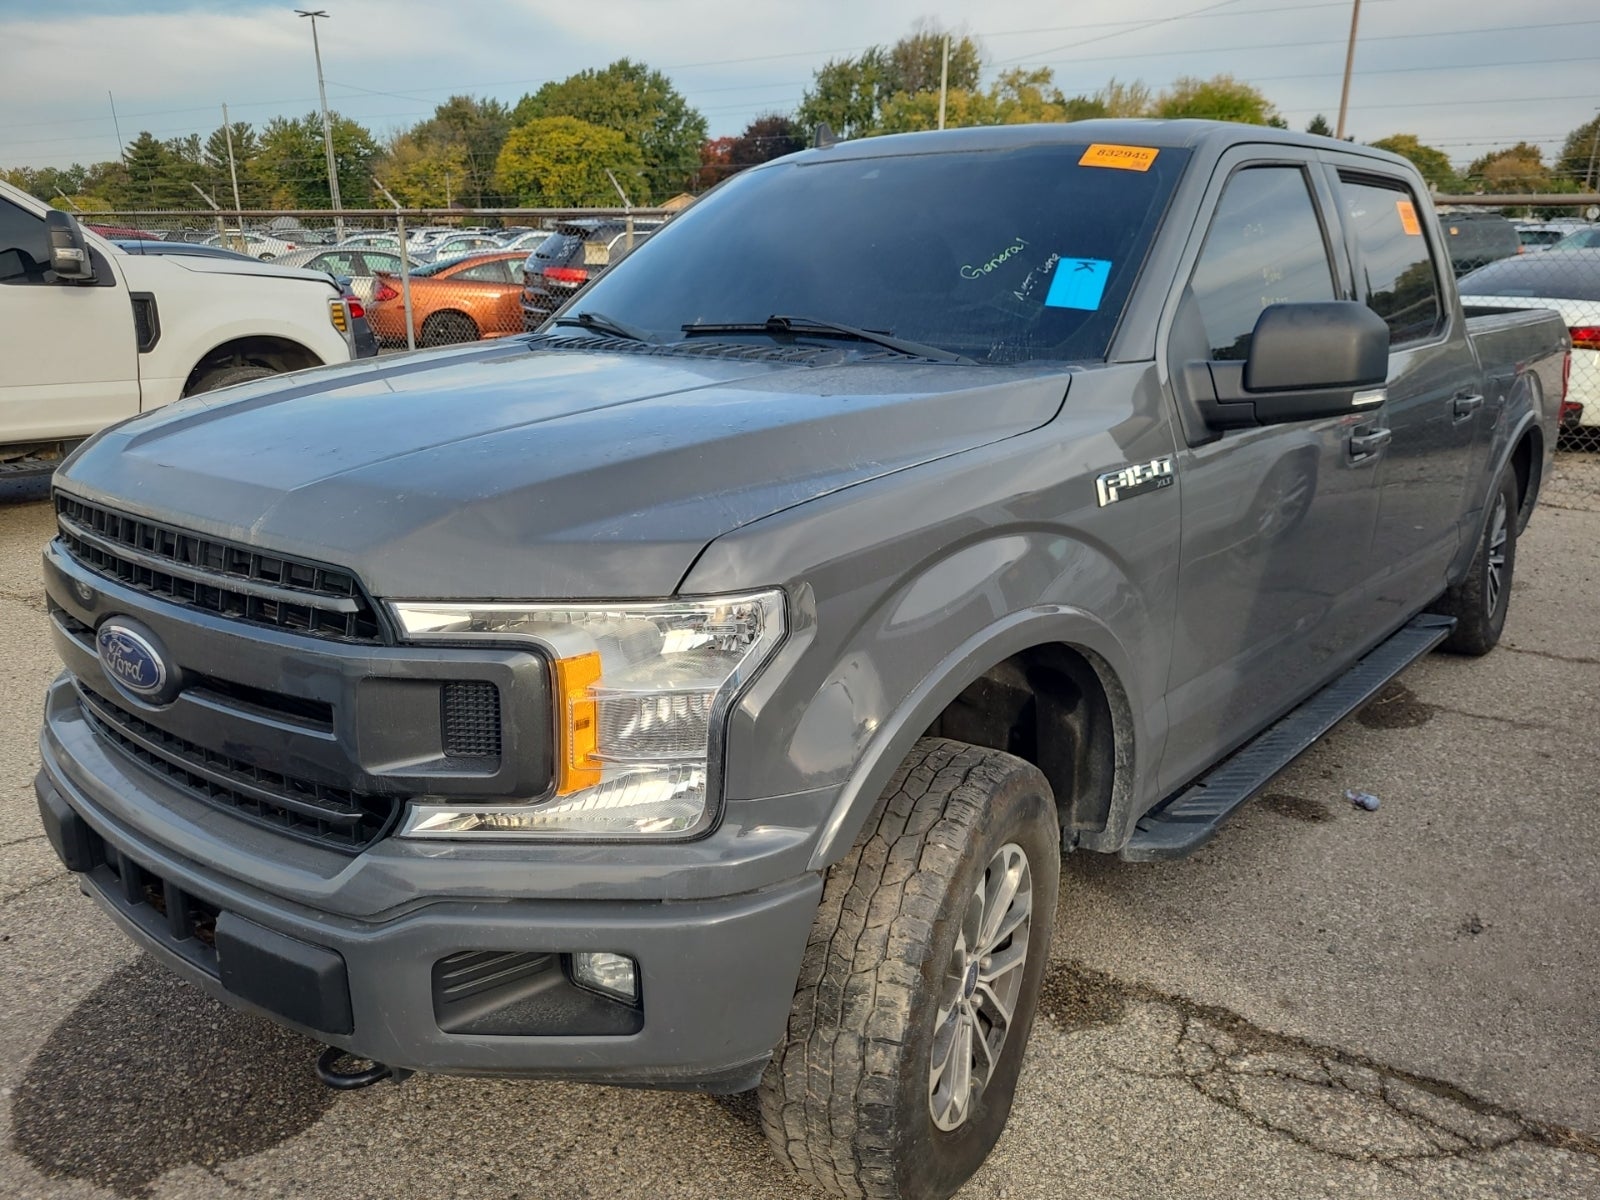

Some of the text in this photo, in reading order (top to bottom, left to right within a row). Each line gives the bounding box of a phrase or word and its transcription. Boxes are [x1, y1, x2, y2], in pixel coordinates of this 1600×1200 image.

[1097, 149, 1149, 160] 832945
[960, 237, 1029, 279] General
[1074, 261, 1097, 273] K
[1156, 478, 1171, 488] XLT
[107, 639, 143, 681] Ford
